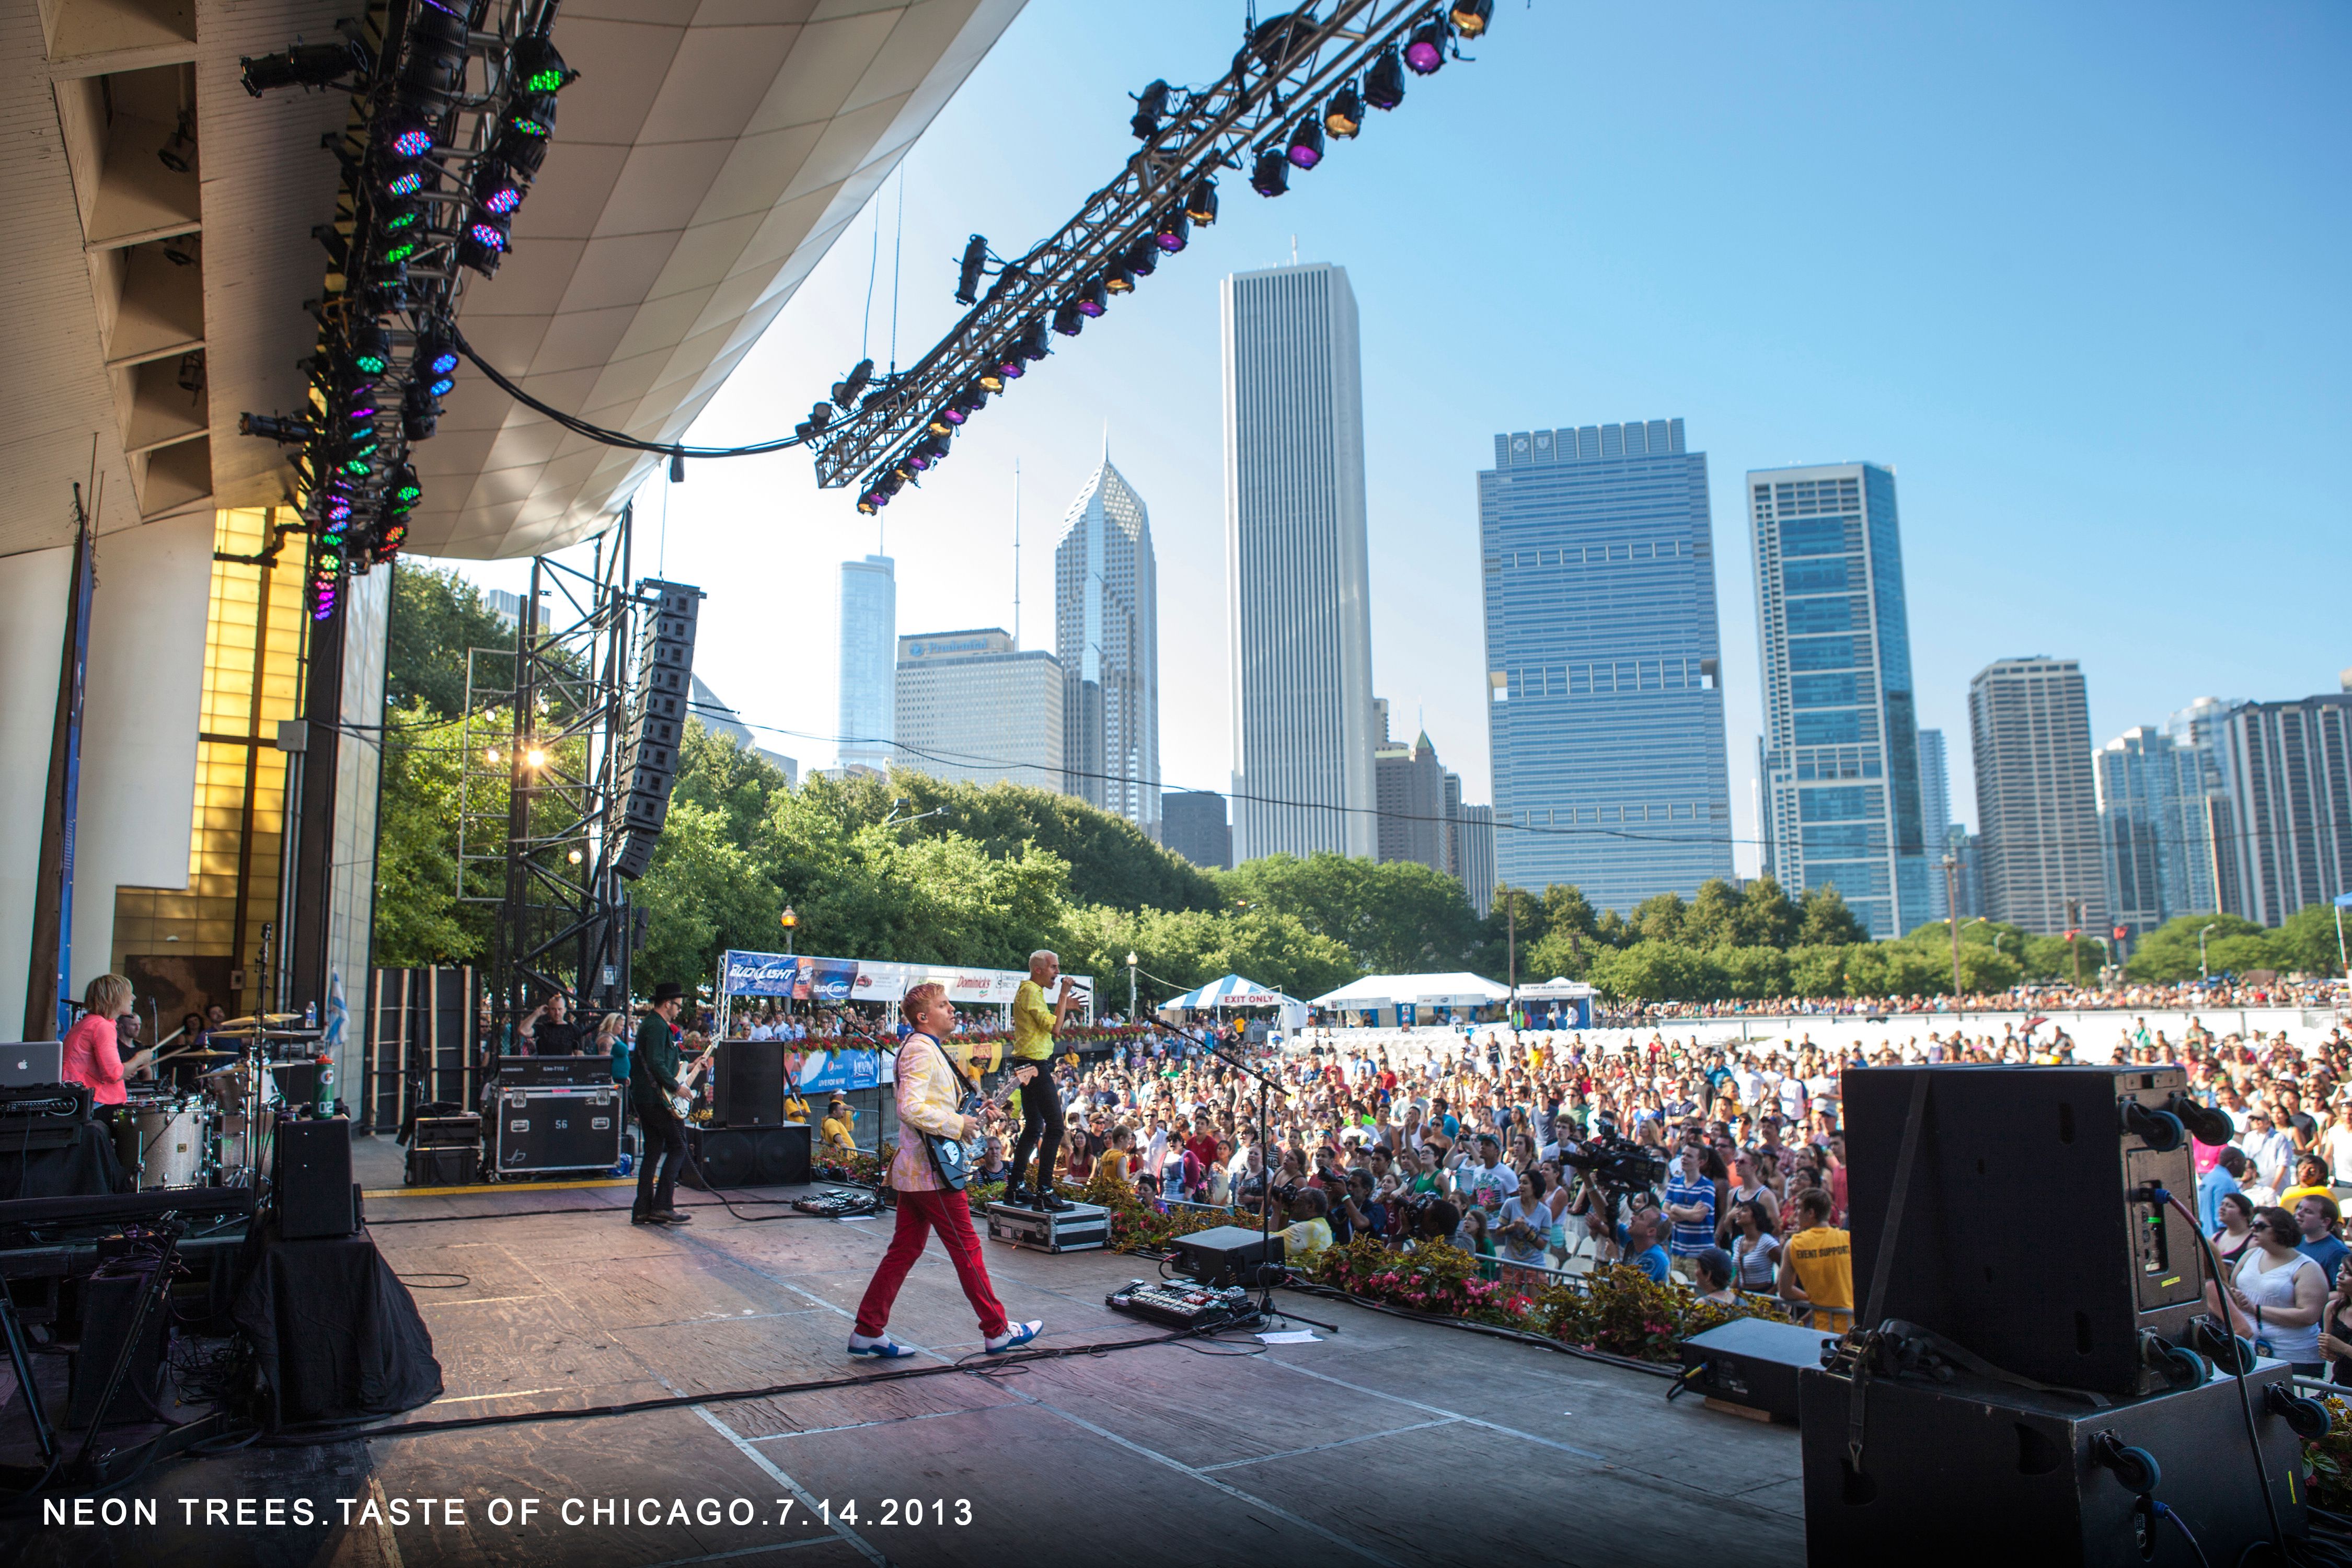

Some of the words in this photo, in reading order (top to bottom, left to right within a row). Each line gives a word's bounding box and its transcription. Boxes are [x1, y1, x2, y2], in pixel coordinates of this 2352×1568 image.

[928, 636, 988, 653] Prudential
[729, 964, 753, 978] BUD
[758, 967, 795, 980] LIGHT
[813, 984, 827, 993] BUD
[829, 985, 849, 993] LIGHT
[318, 1101, 333, 1114] 02
[555, 1120, 568, 1129] 56
[1796, 1249, 1817, 1259] EVENT
[1819, 1246, 1850, 1258] SUPPORT
